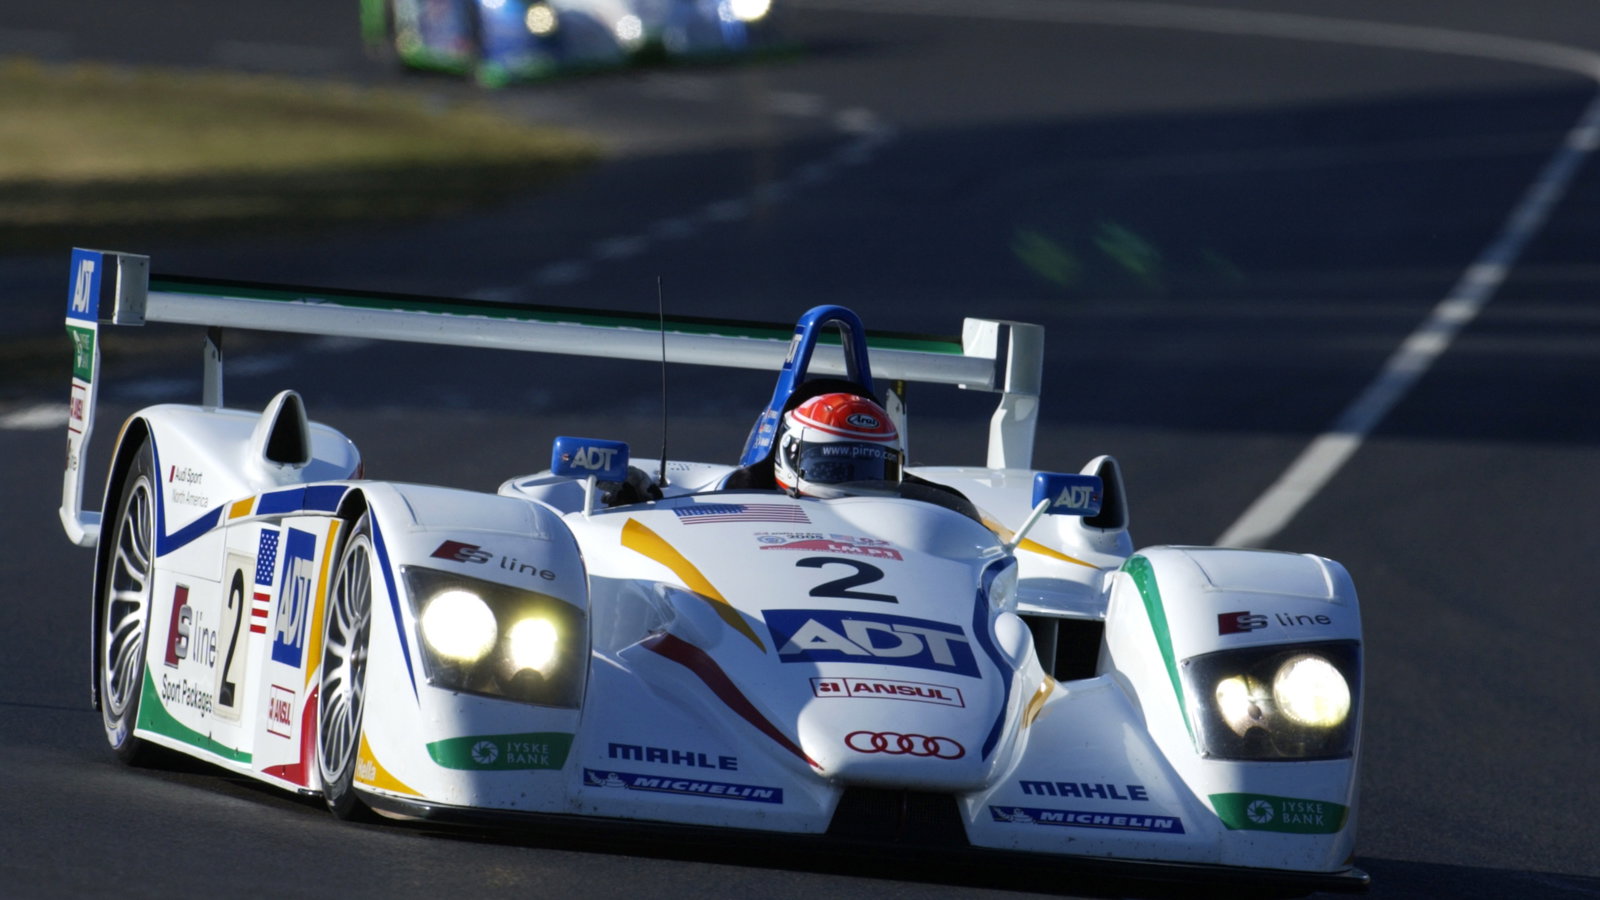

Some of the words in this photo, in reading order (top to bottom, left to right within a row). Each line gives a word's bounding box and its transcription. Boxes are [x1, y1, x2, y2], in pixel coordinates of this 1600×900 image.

[72, 259, 95, 314] ADT
[570, 446, 618, 471] ADT
[175, 466, 187, 481] Audi
[187, 468, 202, 485] Sport
[1053, 486, 1094, 509] ADT
[500, 556, 556, 581] line
[796, 556, 899, 604] 2
[274, 555, 314, 648] ADT
[1275, 613, 1332, 626] line
[193, 611, 217, 669] line
[219, 568, 244, 708] 2
[778, 618, 969, 666] ADT
[162, 673, 181, 707] Sport
[180, 679, 213, 718] Packages
[853, 683, 952, 701] ANSUL
[506, 742, 550, 754] JYSKE
[506, 752, 550, 765] BANK
[608, 742, 738, 771] MAHLE
[632, 776, 775, 799] MICHELIN
[1019, 780, 1149, 801] MAHLE
[1282, 801, 1324, 814] JYSKE
[1040, 811, 1174, 829] MICHELIN
[1282, 813, 1324, 826] BANK
